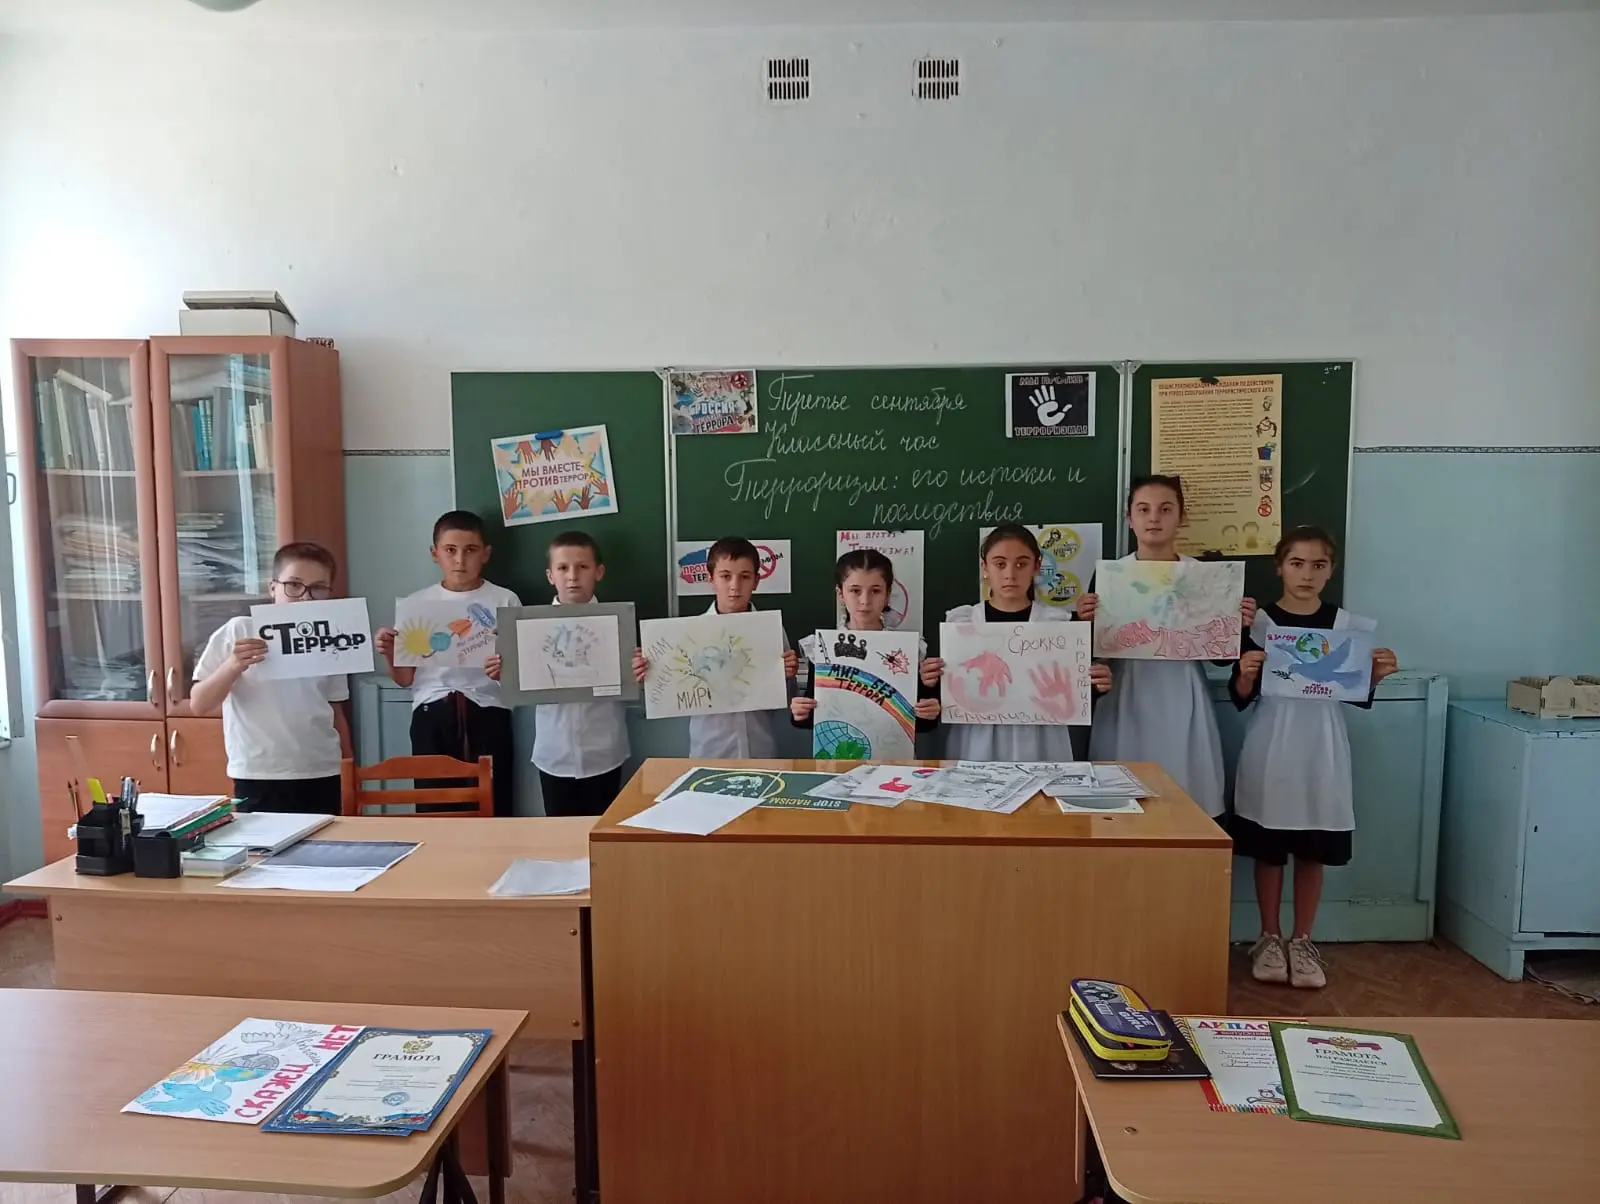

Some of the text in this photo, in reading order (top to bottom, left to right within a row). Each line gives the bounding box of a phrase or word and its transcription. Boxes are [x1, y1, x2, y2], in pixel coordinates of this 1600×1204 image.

[695, 402, 735, 415] РОССИЯ
[768, 372, 967, 426] Третье сентября
[765, 420, 940, 459] Классный час
[515, 472, 595, 490] ПРОТИВ ТЕРРОРА
[521, 467, 539, 478] МЫ
[725, 458, 1087, 520] Терроризм: его истоки и
[872, 490, 1024, 541] последствия
[684, 564, 708, 574] ПРОТ
[259, 620, 330, 654] СТОП
[273, 622, 366, 654] ТЕРРОР
[828, 664, 897, 699] МИР БЕЗ
[835, 677, 886, 706] ТЕРРОРА
[677, 687, 712, 711] МИР!
[768, 797, 841, 808] STOP RACISM
[1119, 1011, 1145, 1031] GIRL
[1198, 1021, 1268, 1031] ДИПЛО
[313, 1024, 360, 1051] НЕТ
[372, 1053, 441, 1061] ГРАМОТА
[1315, 1048, 1382, 1061] ГРАМОТА
